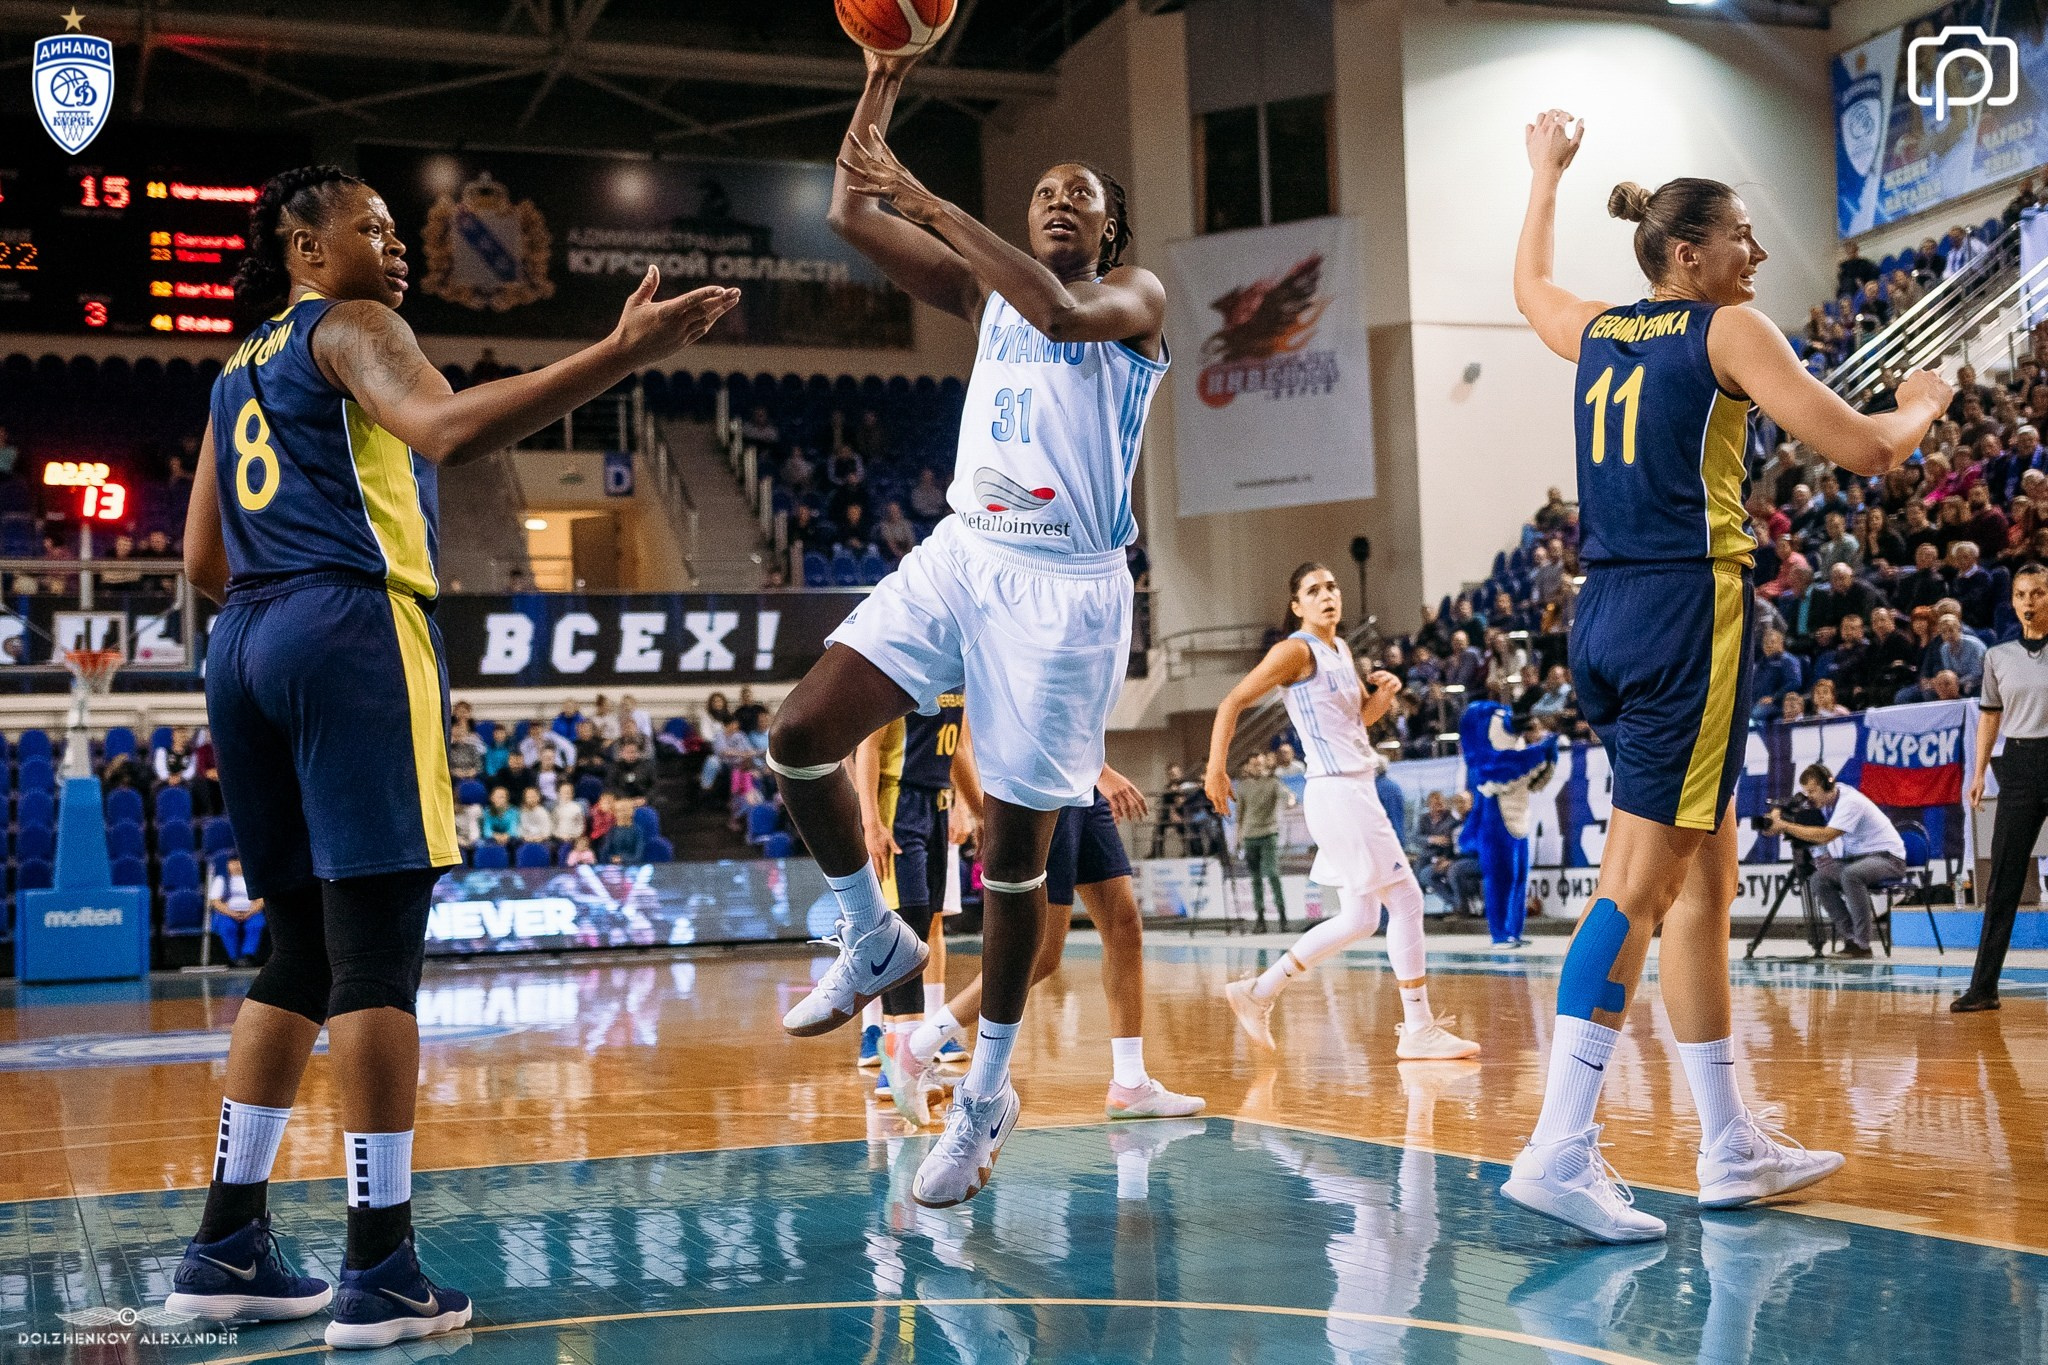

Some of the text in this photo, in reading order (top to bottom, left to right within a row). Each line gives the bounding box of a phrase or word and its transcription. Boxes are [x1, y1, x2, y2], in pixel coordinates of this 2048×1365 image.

[80, 175, 130, 208] 15
[568, 250, 849, 282] КУРСКОЙ ОБЛАСТИ
[84, 302, 108, 327] 3
[991, 387, 1032, 444] 31
[1585, 365, 1645, 465] 11
[234, 397, 280, 511] 8
[82, 482, 126, 520] 13
[479, 611, 781, 675] ВСЕХ!
[936, 723, 958, 756] 10
[1867, 729, 1959, 768] КУРСК
[44, 907, 123, 927] molten
[425, 898, 579, 940] NEVER
